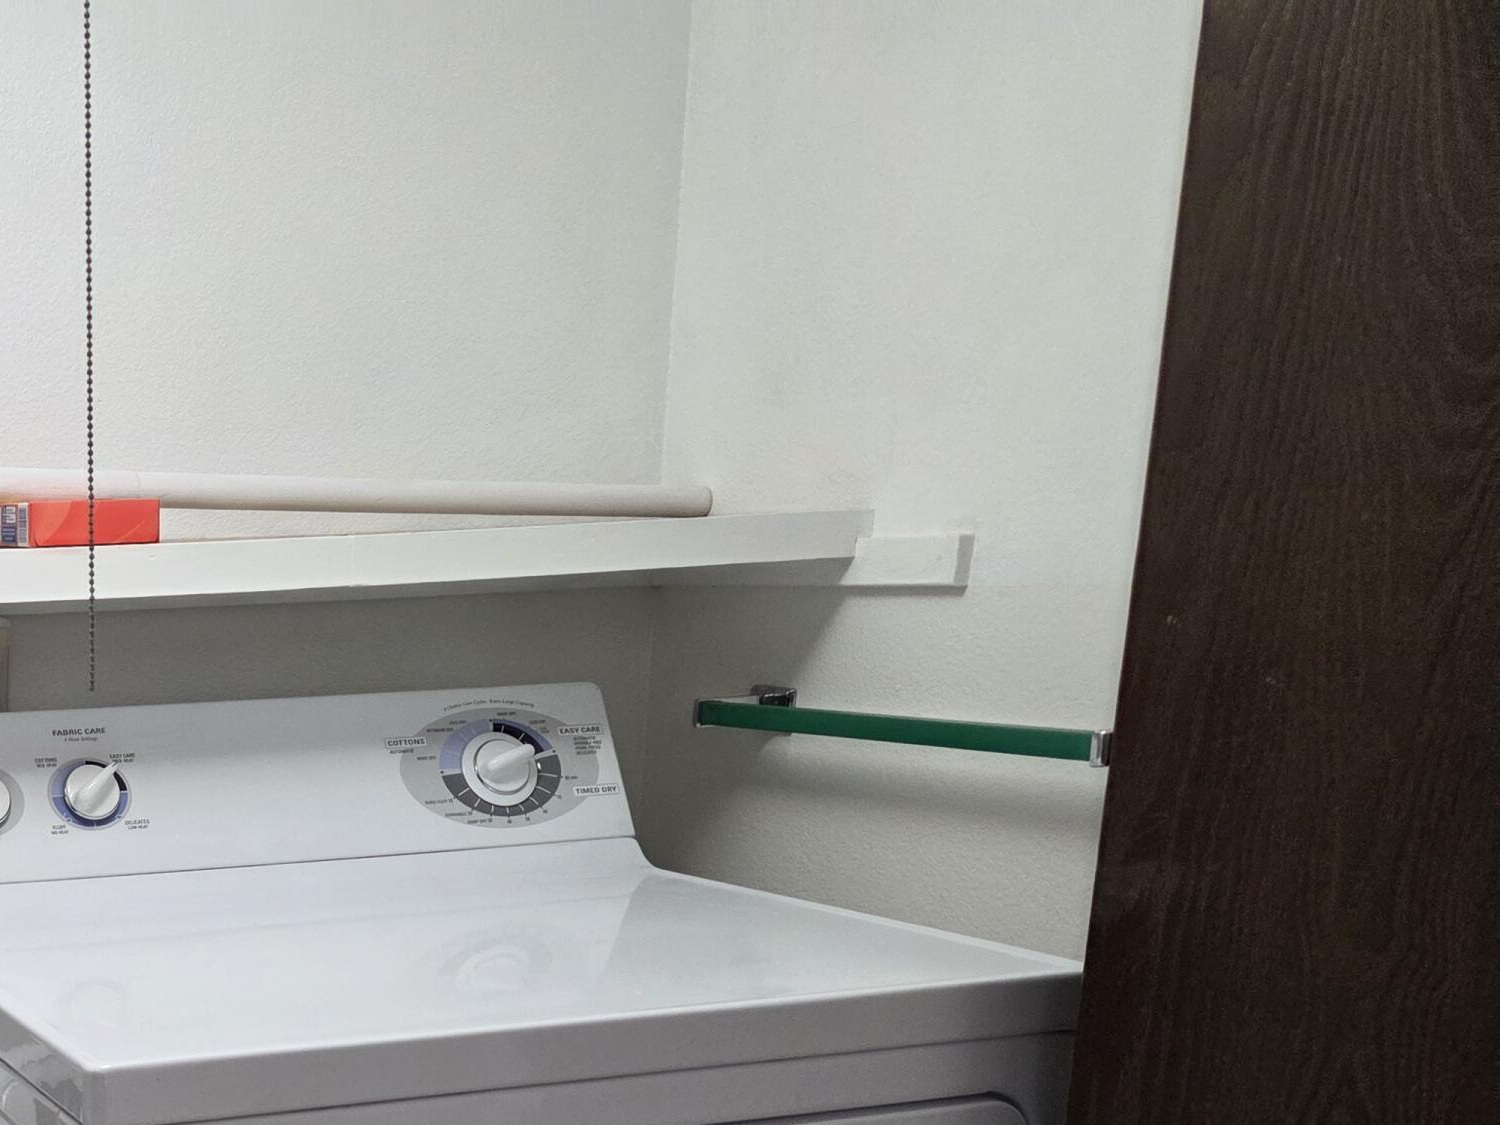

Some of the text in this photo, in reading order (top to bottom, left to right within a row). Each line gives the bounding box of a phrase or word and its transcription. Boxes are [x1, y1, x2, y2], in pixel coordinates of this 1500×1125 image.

[52, 727, 106, 736] FABRIC CARE
[560, 727, 579, 735] EASY
[387, 738, 425, 747] COTTONS
